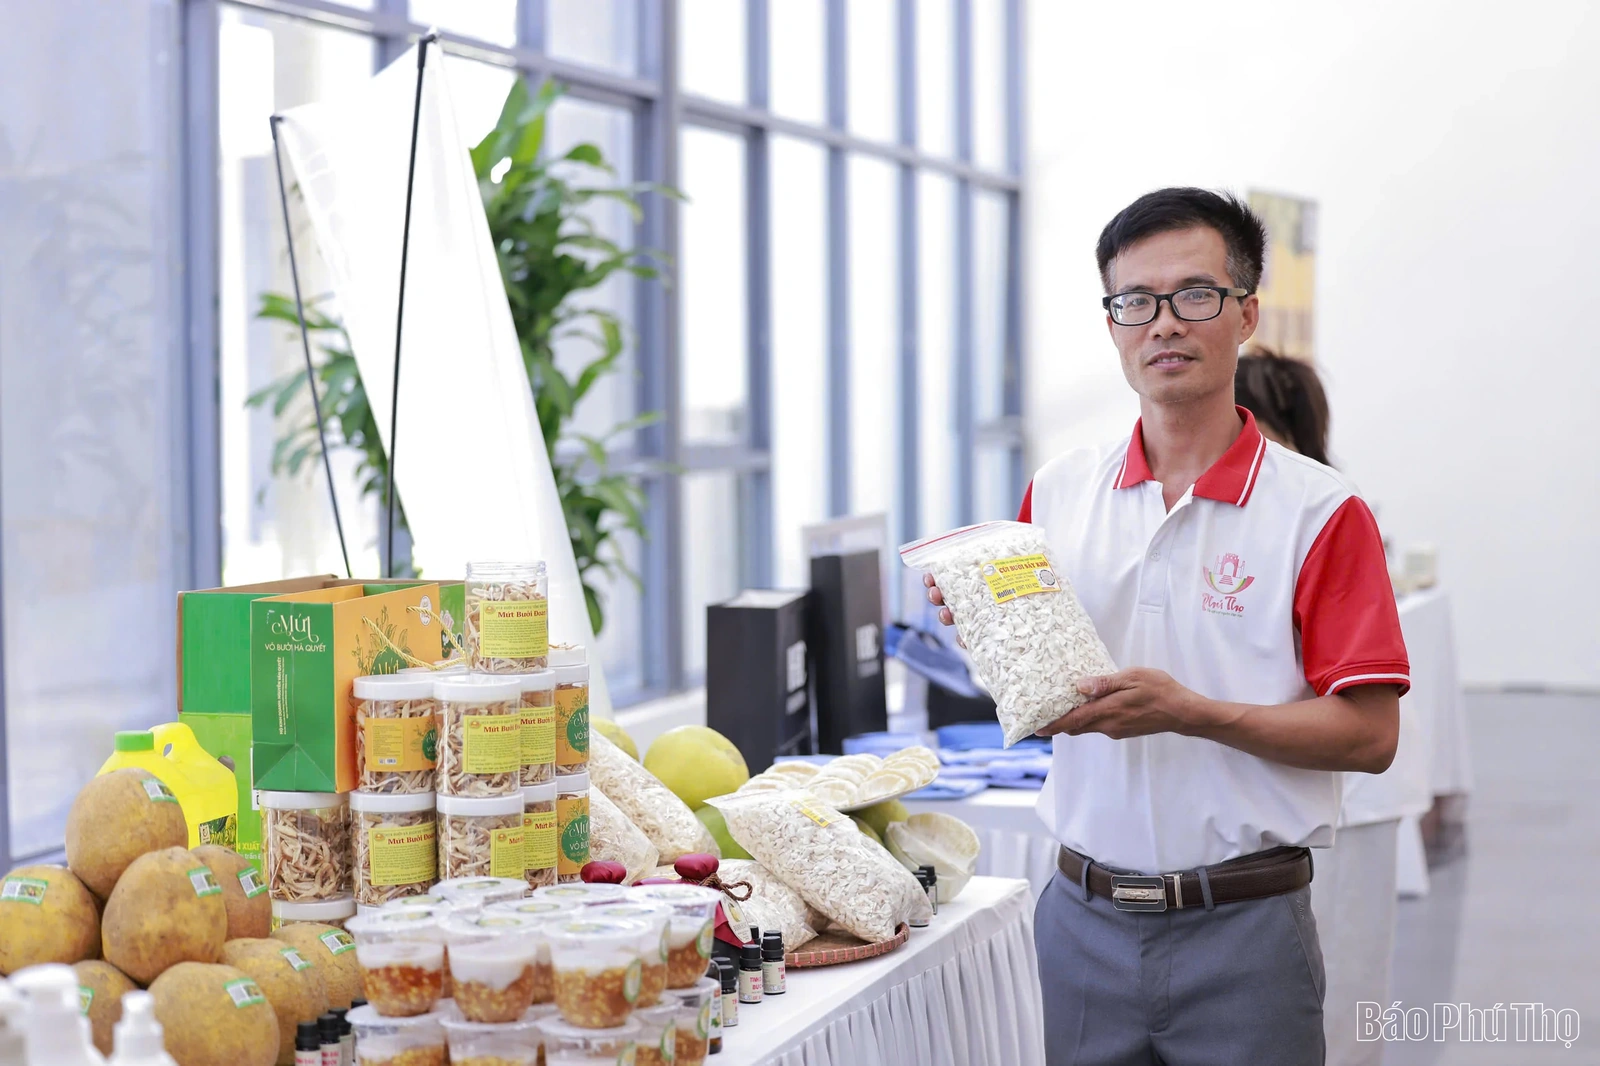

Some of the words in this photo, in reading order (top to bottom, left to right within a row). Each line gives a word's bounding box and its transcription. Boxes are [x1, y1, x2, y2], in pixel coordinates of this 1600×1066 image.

[1202, 592, 1224, 611] Phú
[516, 610, 533, 618] Bưởi
[271, 613, 320, 643] Mứt
[264, 641, 276, 651] VỎ
[276, 642, 293, 652] BƯỞI
[305, 642, 327, 652] QUYẾT
[534, 821, 548, 829] Mứt
[242, 840, 260, 850] XUẤT
[387, 837, 404, 845] Mứt
[406, 834, 423, 843] Bưởi
